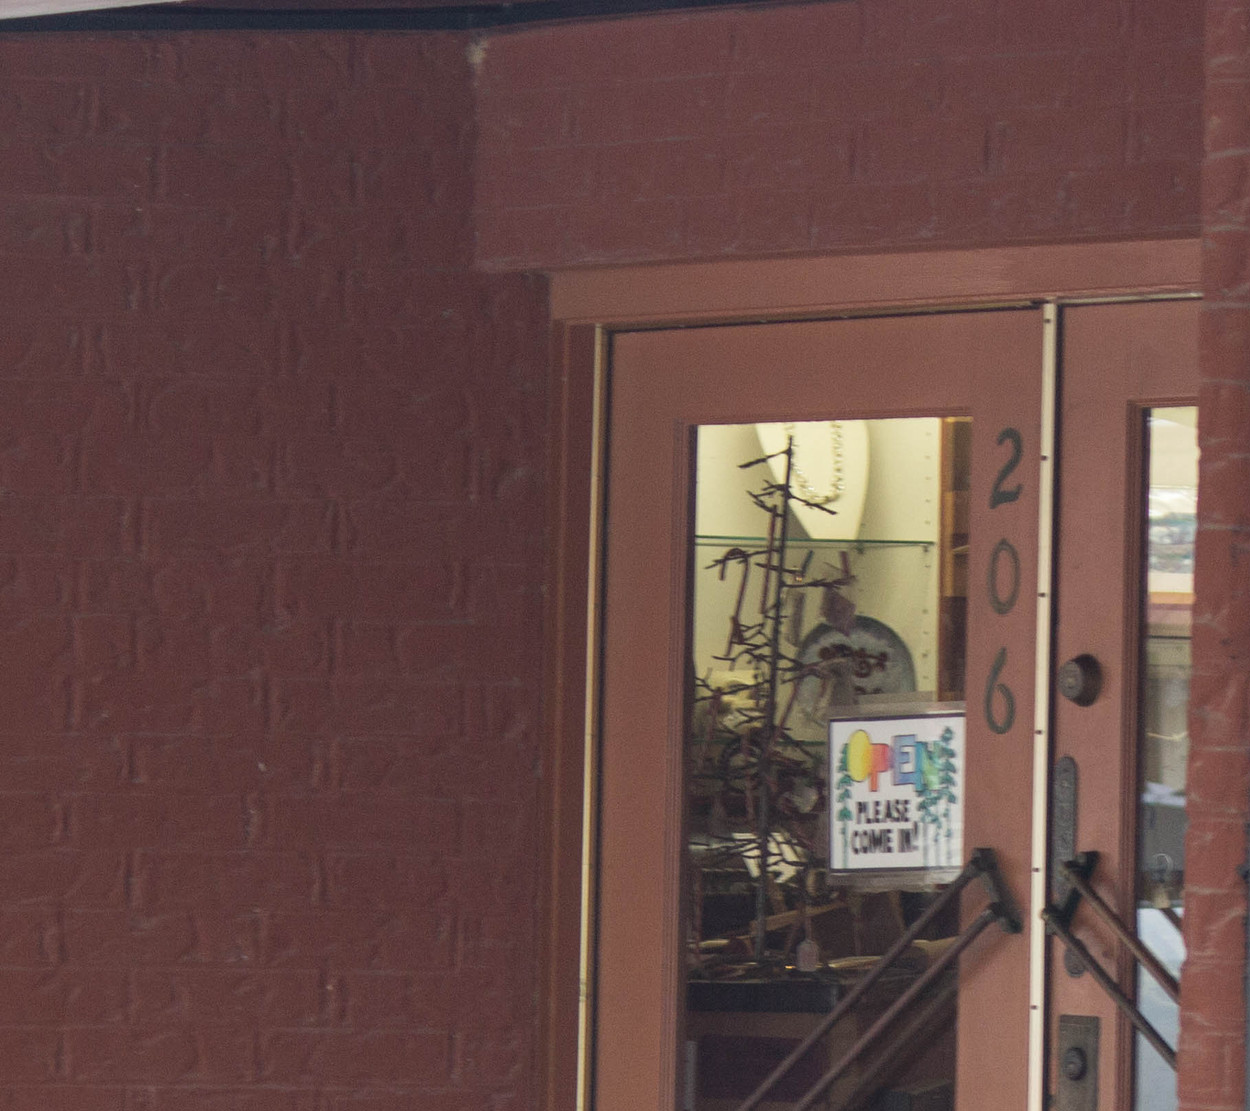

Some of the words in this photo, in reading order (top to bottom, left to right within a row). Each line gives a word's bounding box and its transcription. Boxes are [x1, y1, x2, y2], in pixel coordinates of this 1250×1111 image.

[847, 729, 943, 793] OPEN
[855, 799, 911, 824] PLEASE
[852, 828, 894, 855] COME
